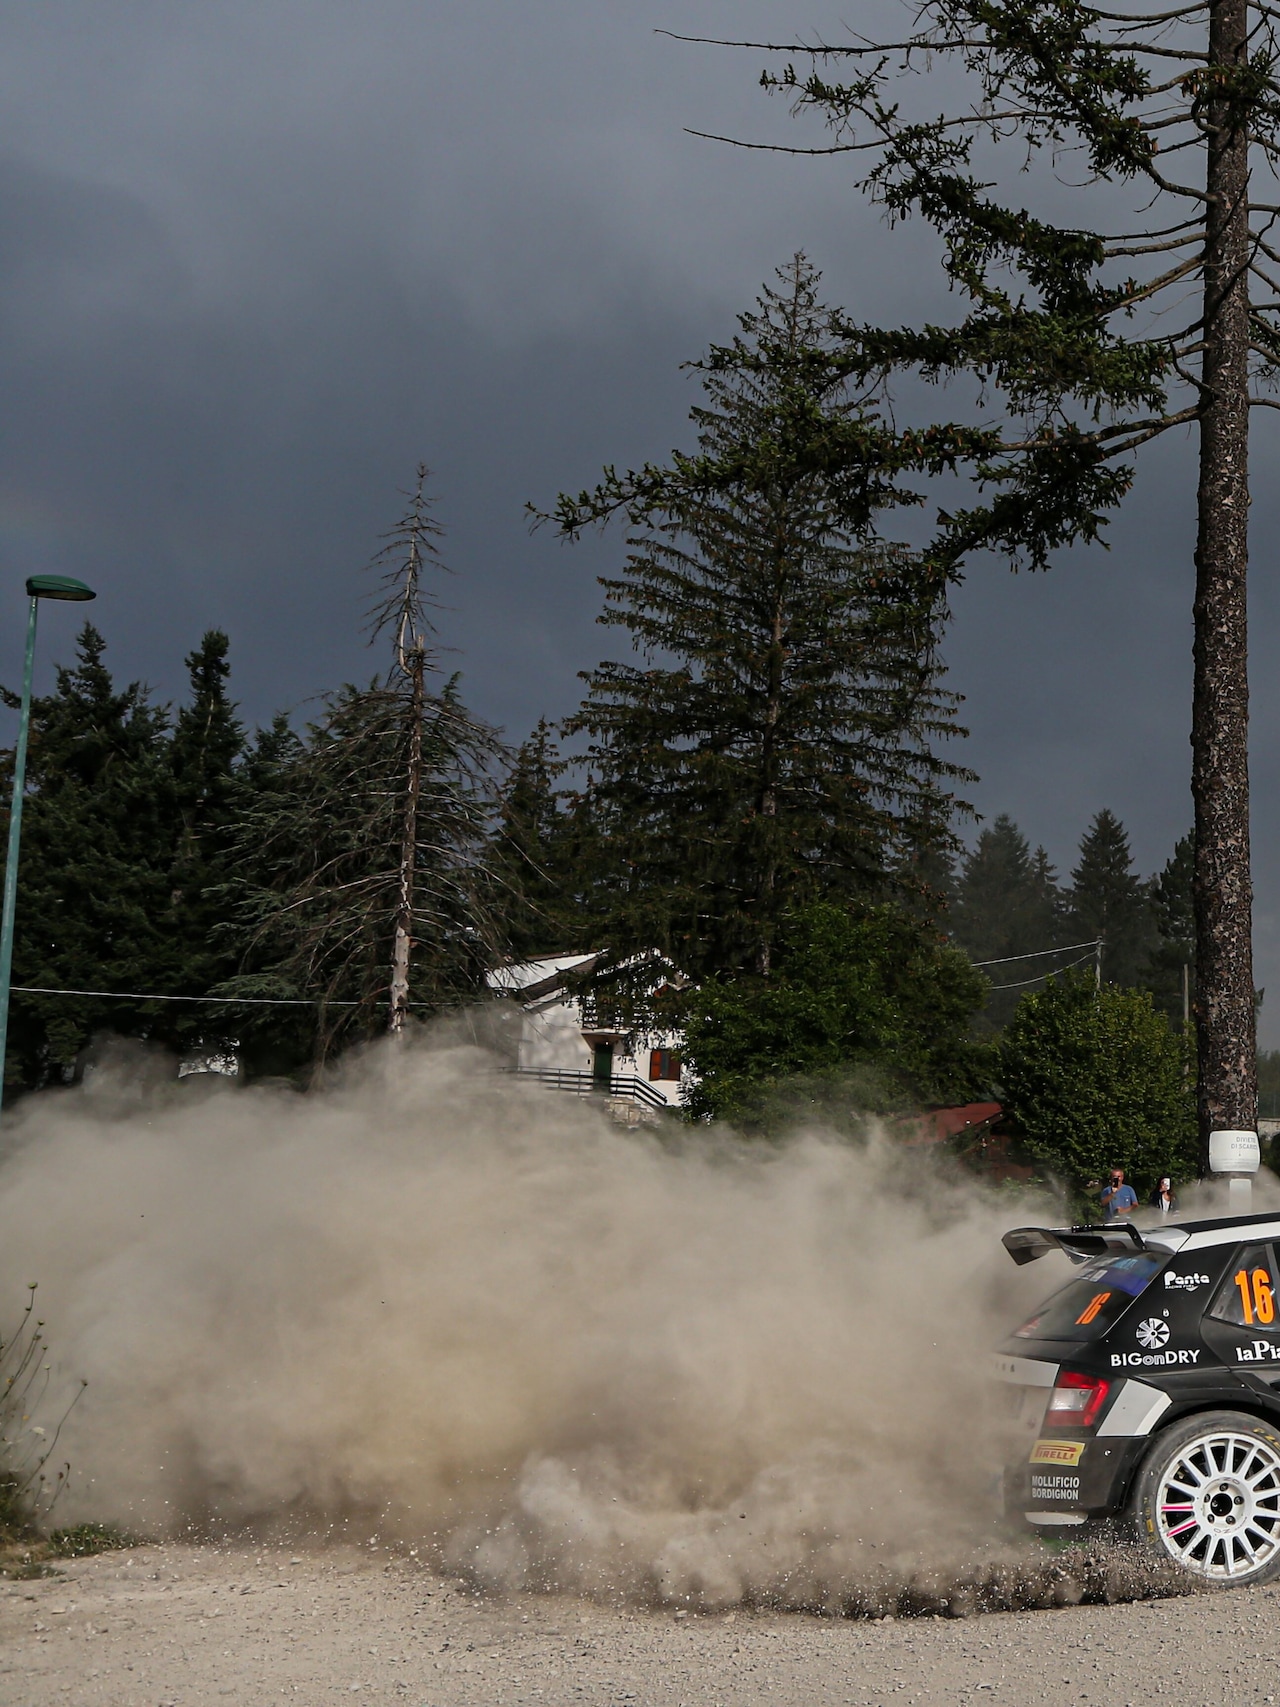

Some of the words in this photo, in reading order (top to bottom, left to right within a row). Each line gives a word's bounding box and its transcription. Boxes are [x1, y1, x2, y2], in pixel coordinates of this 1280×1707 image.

[1164, 1270, 1210, 1285] Panta
[1234, 1268, 1275, 1325] 16
[1075, 1291, 1112, 1326] 16
[1110, 1349, 1201, 1367] BIGonDRY
[1034, 1445, 1077, 1460] PIRELLI
[1031, 1475, 1080, 1488] MOLLIFICIO
[1031, 1487, 1079, 1500] BORDIGNON
